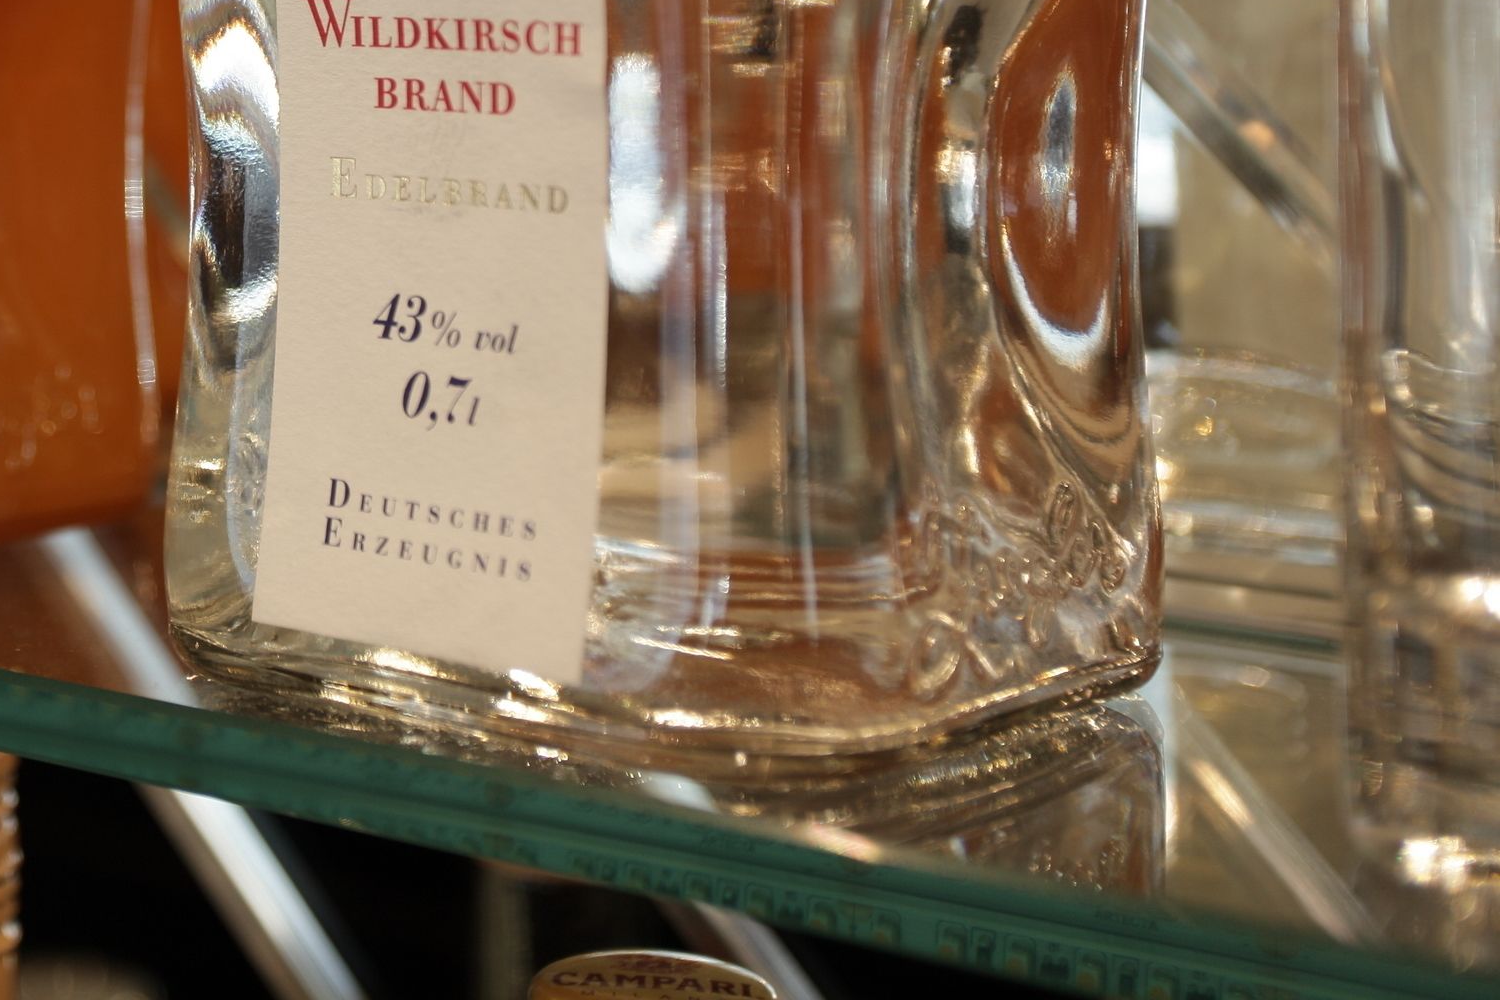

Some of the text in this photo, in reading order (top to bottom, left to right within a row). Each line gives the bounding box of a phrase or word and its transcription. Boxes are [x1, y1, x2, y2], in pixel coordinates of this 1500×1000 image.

[373, 76, 517, 117] BRAND
[373, 292, 519, 354] 43% vol
[552, 971, 754, 999] CAMPARI
